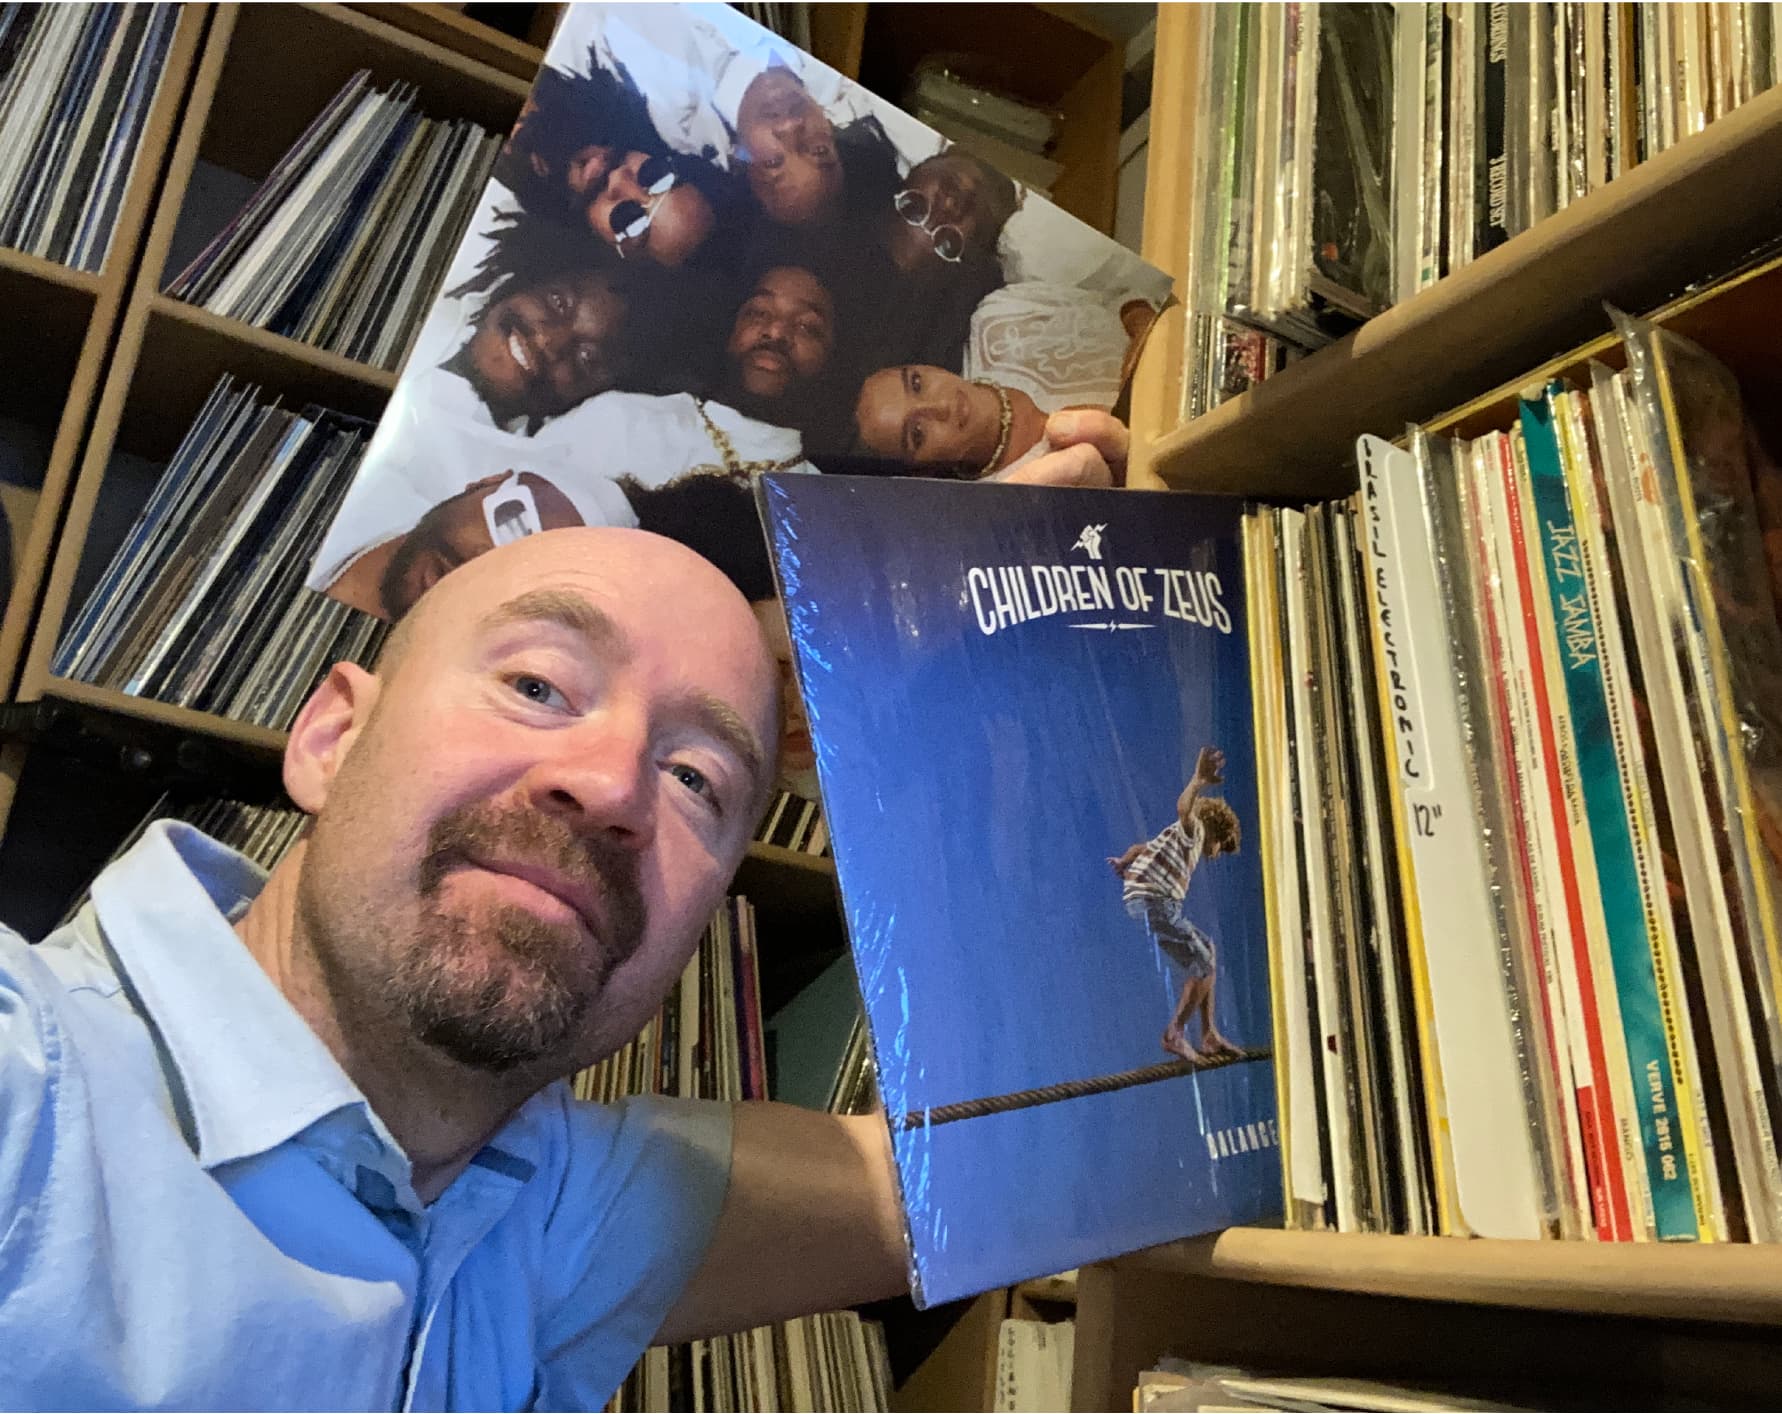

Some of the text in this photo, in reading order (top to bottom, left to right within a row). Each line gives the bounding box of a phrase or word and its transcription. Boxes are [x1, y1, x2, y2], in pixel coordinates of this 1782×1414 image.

[1547, 519, 1583, 583] JAZZ
[967, 565, 1233, 636] CHILDREN OF ZEUS
[1376, 567, 1420, 778] ELECTRONIC
[1412, 802, 1443, 838] 12"
[1646, 1059, 1667, 1115] VERVE
